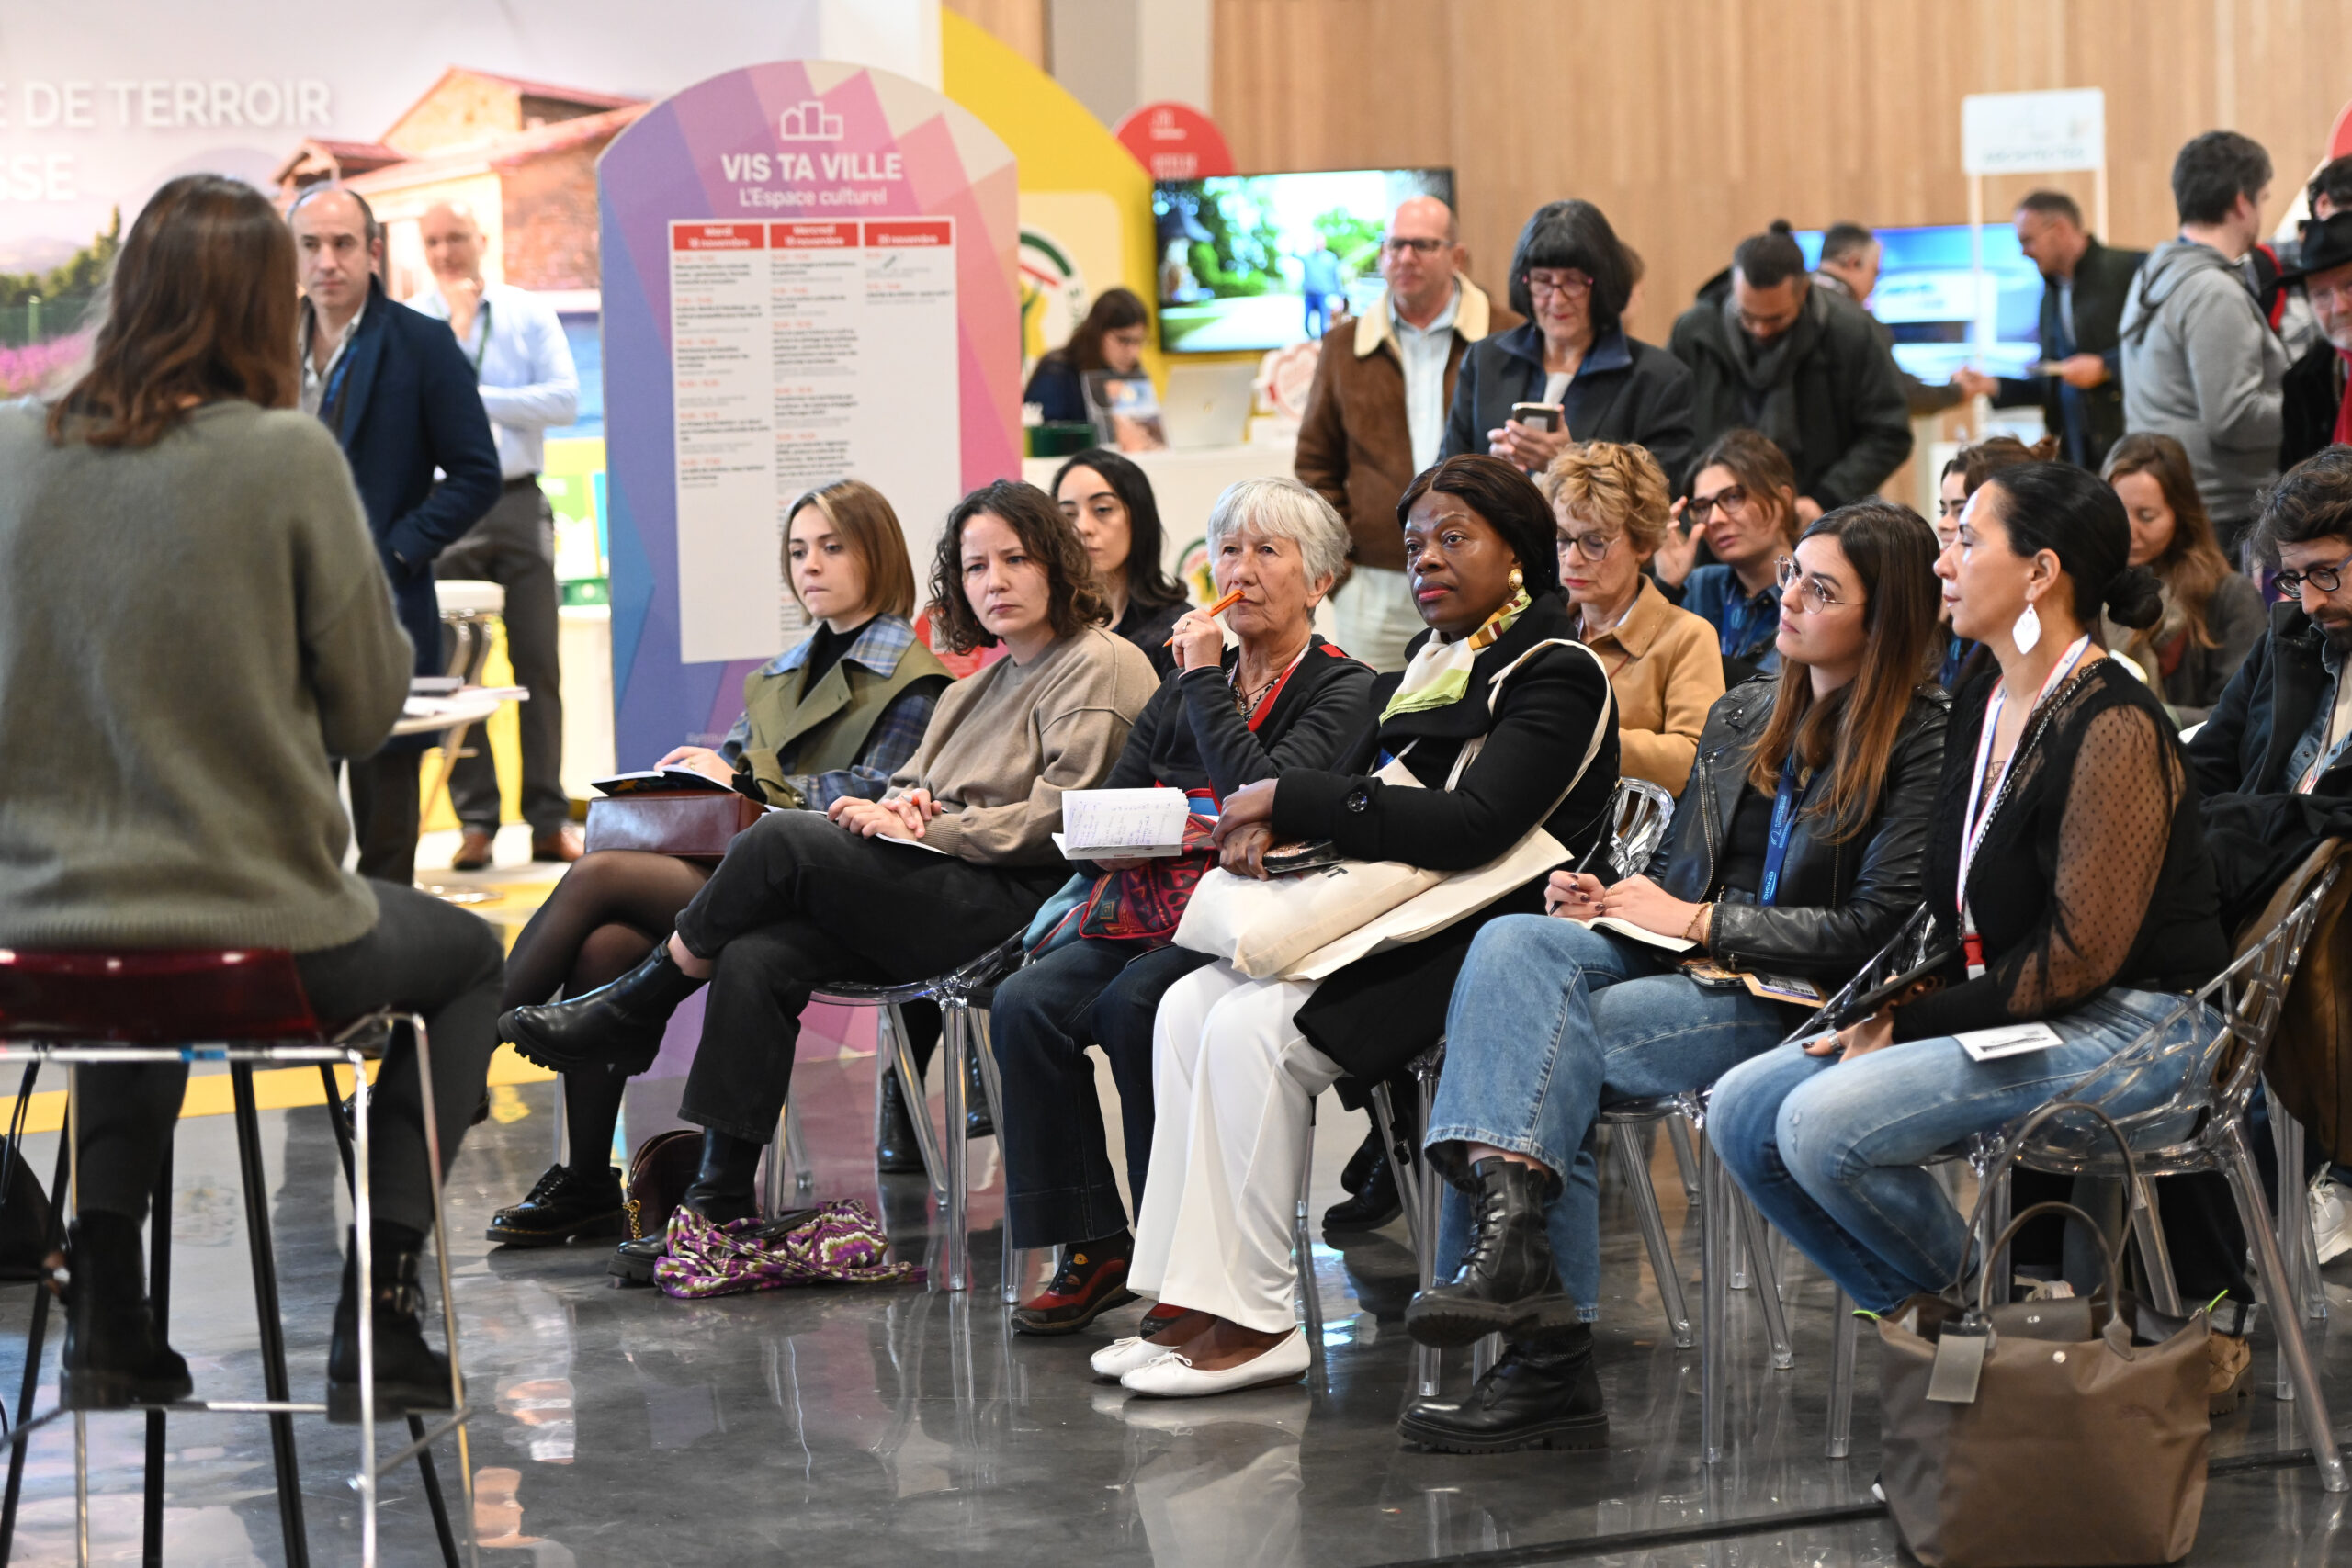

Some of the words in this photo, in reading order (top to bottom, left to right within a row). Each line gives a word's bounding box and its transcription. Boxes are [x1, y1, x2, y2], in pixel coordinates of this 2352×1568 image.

[24, 81, 96, 127] DE
[105, 80, 332, 127] TERROIR
[720, 152, 772, 182] VIS
[776, 152, 816, 181] TA
[820, 152, 903, 181] VILLE
[738, 186, 816, 210] L'Espace
[819, 186, 888, 206] culturel
